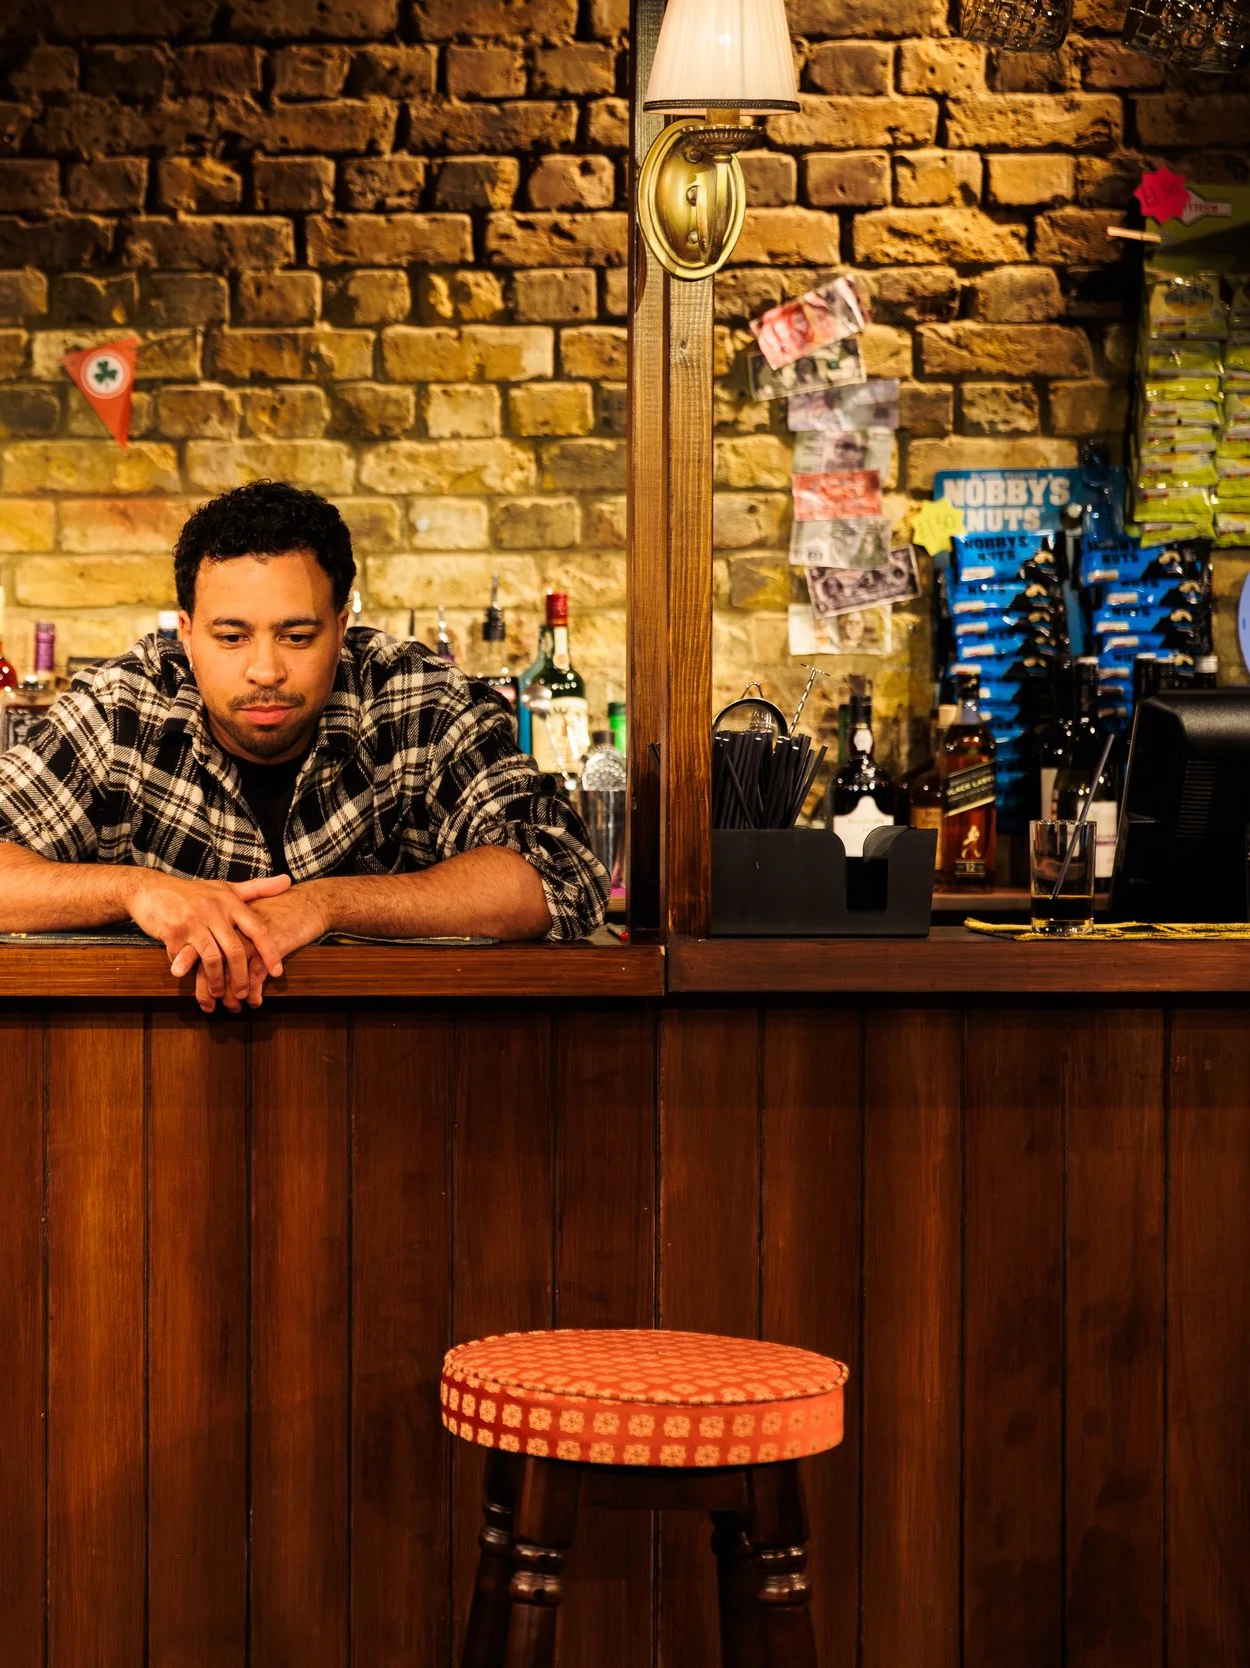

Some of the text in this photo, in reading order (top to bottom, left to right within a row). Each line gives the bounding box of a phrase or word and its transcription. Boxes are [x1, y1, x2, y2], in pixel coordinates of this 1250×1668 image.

[944, 475, 1070, 506] NOBBY'S
[966, 507, 1040, 532] NUTS
[1102, 553, 1139, 564] NUTS
[965, 863, 975, 872] 12
